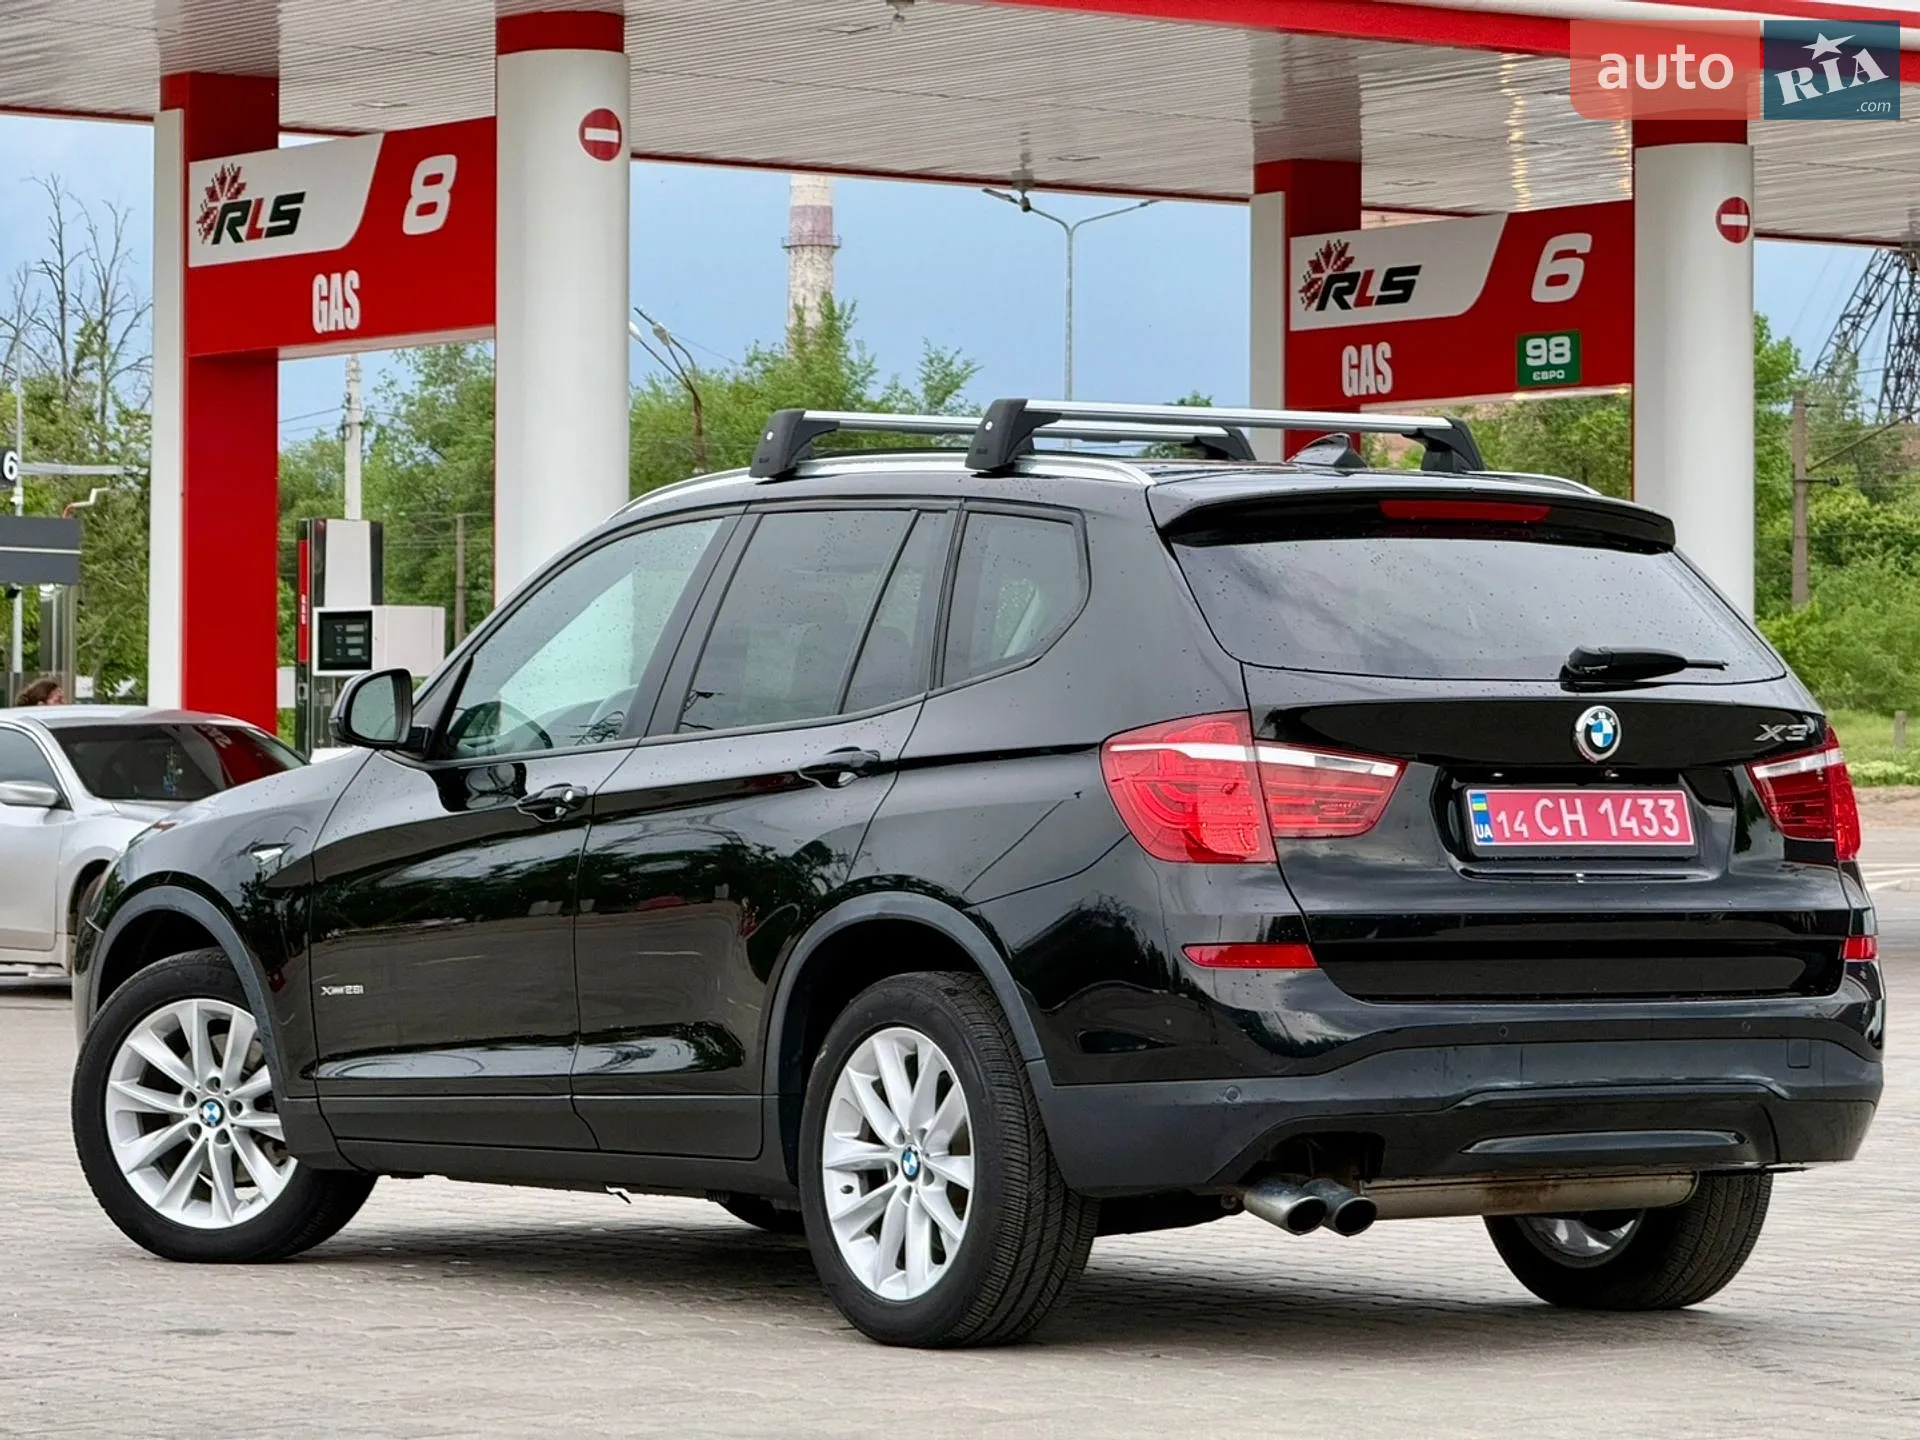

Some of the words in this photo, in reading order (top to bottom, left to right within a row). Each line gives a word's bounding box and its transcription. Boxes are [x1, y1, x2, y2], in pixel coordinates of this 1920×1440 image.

[211, 191, 306, 245] RLS
[402, 154, 458, 236] 8
[1315, 264, 1422, 311] RLS
[1531, 232, 1593, 303] 6
[312, 269, 361, 334] GAS
[1341, 341, 1393, 398] GAS
[1526, 336, 1571, 366] 98
[3, 450, 19, 481] 6
[1753, 723, 1809, 742] X3
[1474, 823, 1494, 840] UA
[1496, 809, 1529, 838] 14
[1534, 798, 1588, 837] CH
[1598, 798, 1680, 837] 1433
